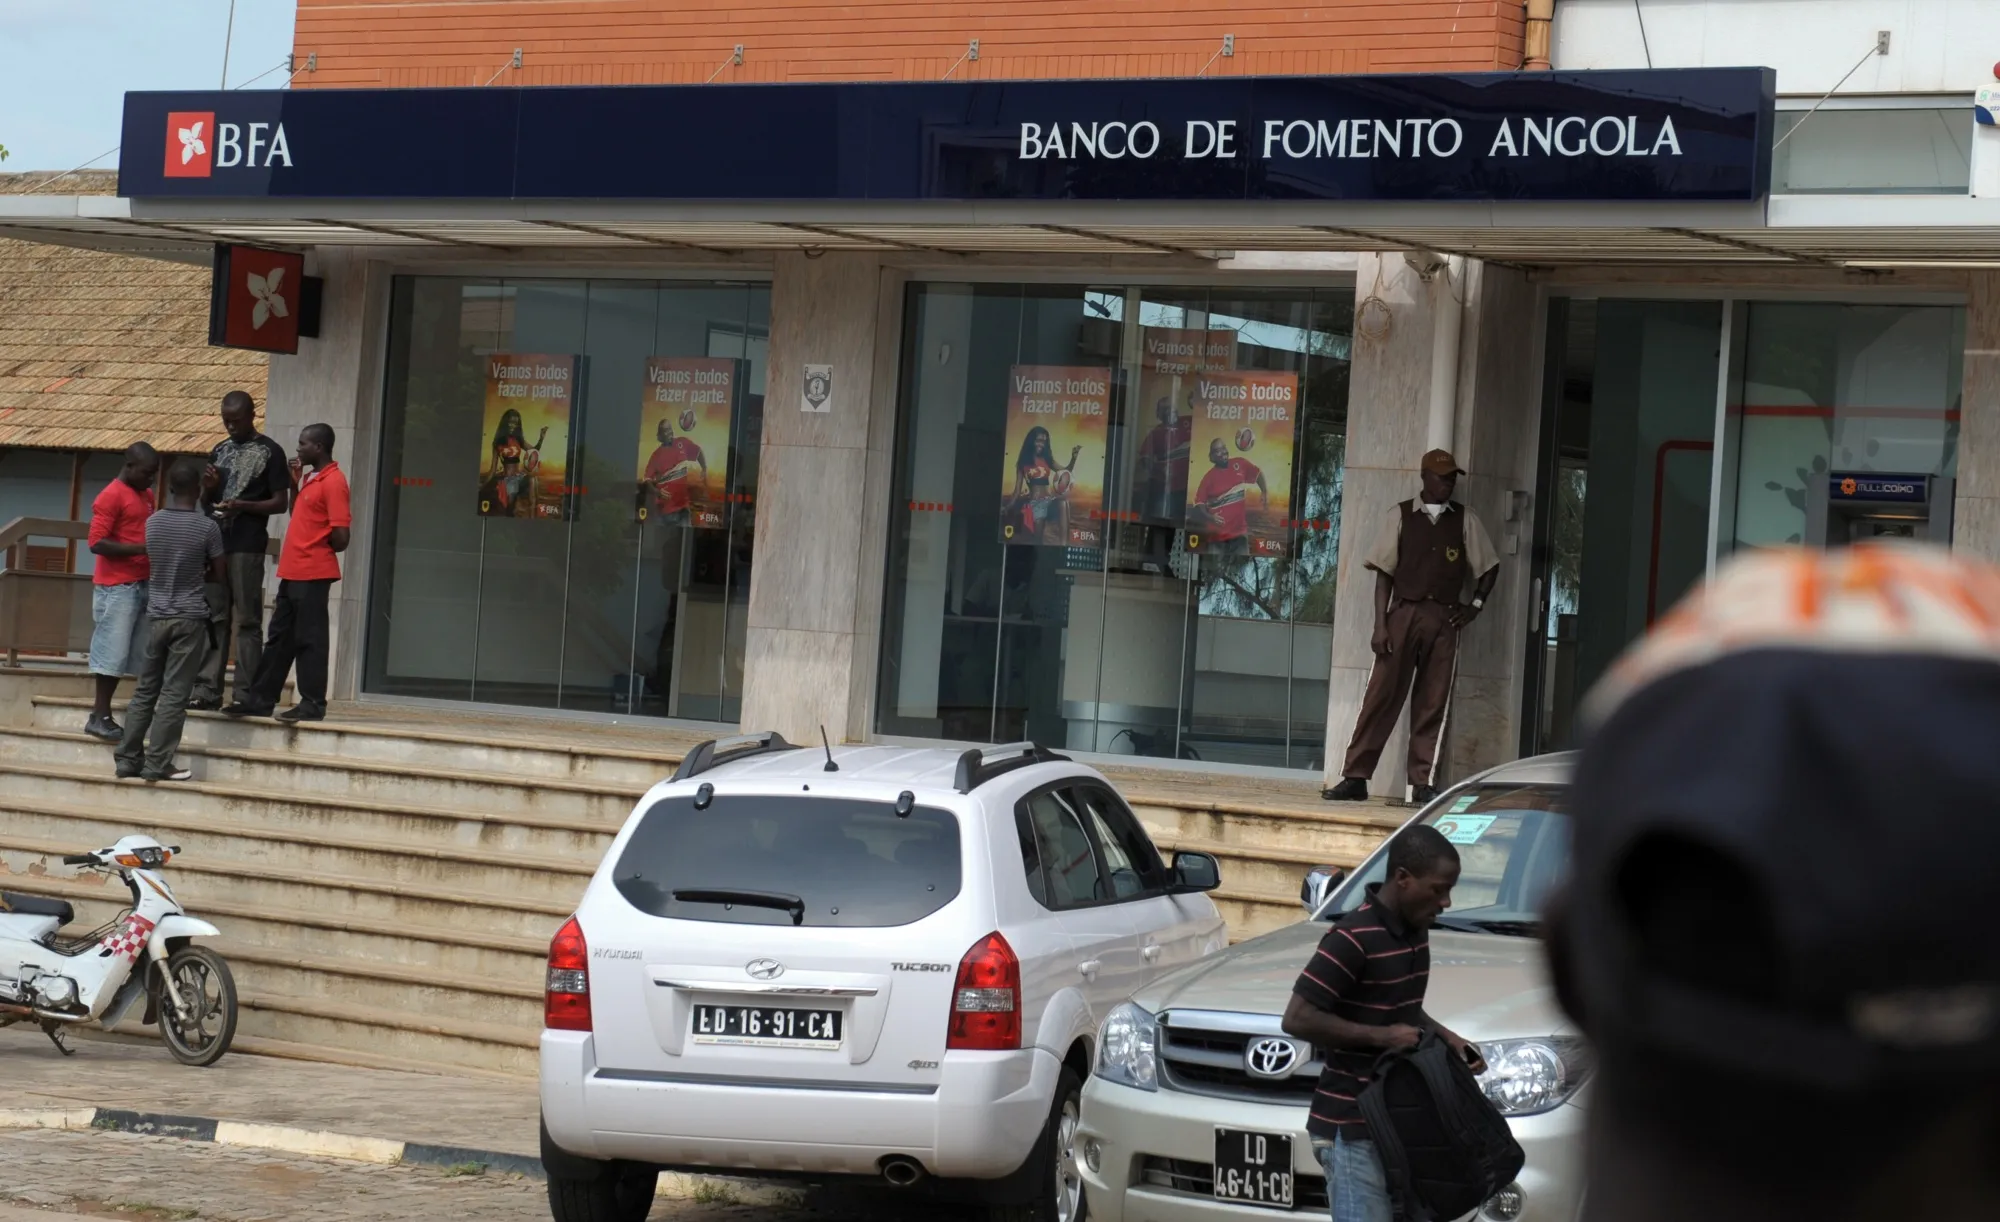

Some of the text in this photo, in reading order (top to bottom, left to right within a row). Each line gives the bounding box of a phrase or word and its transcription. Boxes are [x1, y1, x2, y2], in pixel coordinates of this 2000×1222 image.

[216, 122, 293, 168] BFA
[1019, 115, 1684, 160] BANCO DE FOMENTO ANGOLA
[1148, 338, 1194, 356] Vamos
[492, 362, 568, 380] Vamos todos
[649, 366, 729, 386] Vamos todos
[1155, 358, 1190, 375] fazer
[497, 380, 567, 401] fazer parte.
[655, 384, 727, 407] fazer parte.
[1015, 375, 1105, 396] Vamos todos
[1200, 380, 1292, 401] Vamos todos
[1022, 395, 1103, 418] fazer parte.
[1206, 401, 1290, 424] fazer parte.
[546, 505, 559, 514] BFA
[705, 513, 719, 523] BFA
[1080, 531, 1095, 541] BFA
[1266, 540, 1281, 551] BFA
[593, 948, 643, 960] HYUNDAI
[891, 962, 952, 973] TUCSON
[1244, 1133, 1267, 1165] LD
[1216, 1166, 1291, 1203] 46-41-CB
